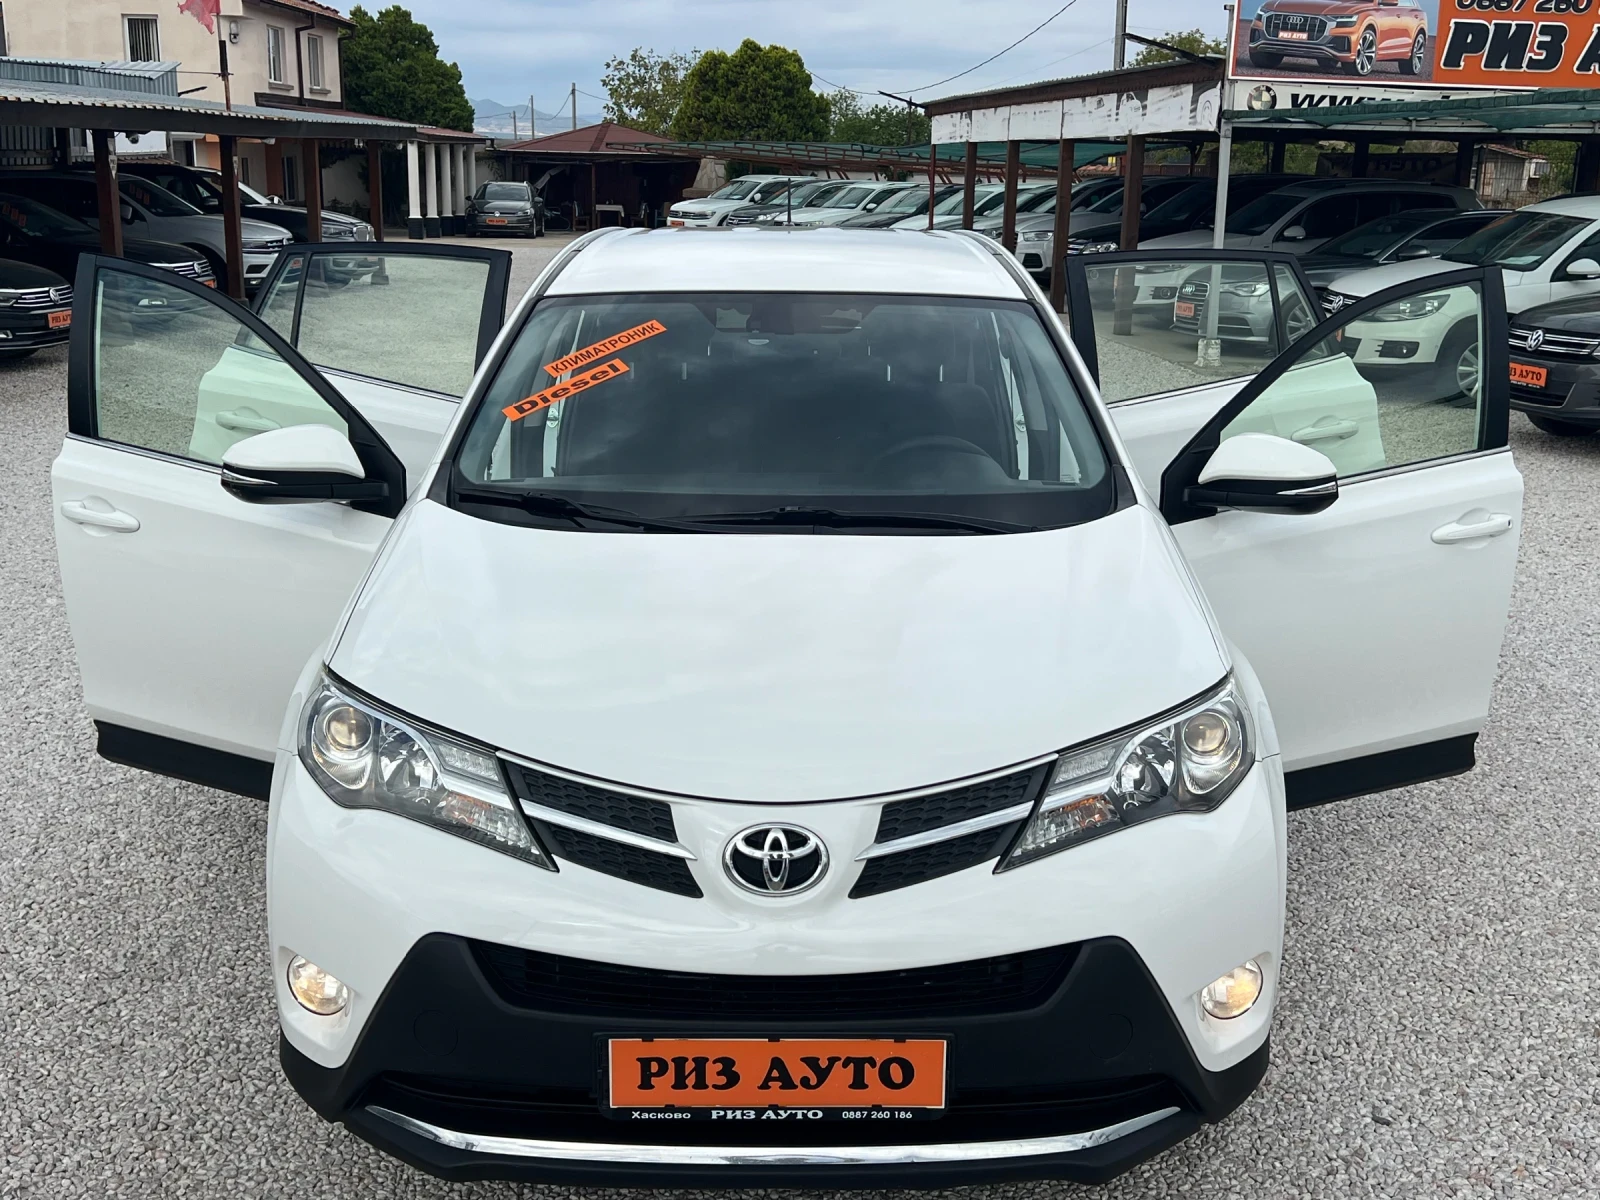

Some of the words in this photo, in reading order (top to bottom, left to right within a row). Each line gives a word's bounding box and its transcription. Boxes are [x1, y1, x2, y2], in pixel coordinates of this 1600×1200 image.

[1441, 19, 1569, 73] РИЗ
[550, 322, 660, 374] КЛИМАТРОНИК
[513, 362, 621, 415] Diesel
[1518, 369, 1542, 381] АУТО
[635, 1056, 741, 1091] РИЗ
[757, 1056, 915, 1091] АУТО
[631, 1111, 691, 1119] Хасково
[711, 1110, 756, 1120] РИЗ
[761, 1110, 823, 1120] АУТО
[842, 1111, 867, 1119] 0887
[871, 1111, 890, 1119] 260
[894, 1111, 912, 1119] 186
